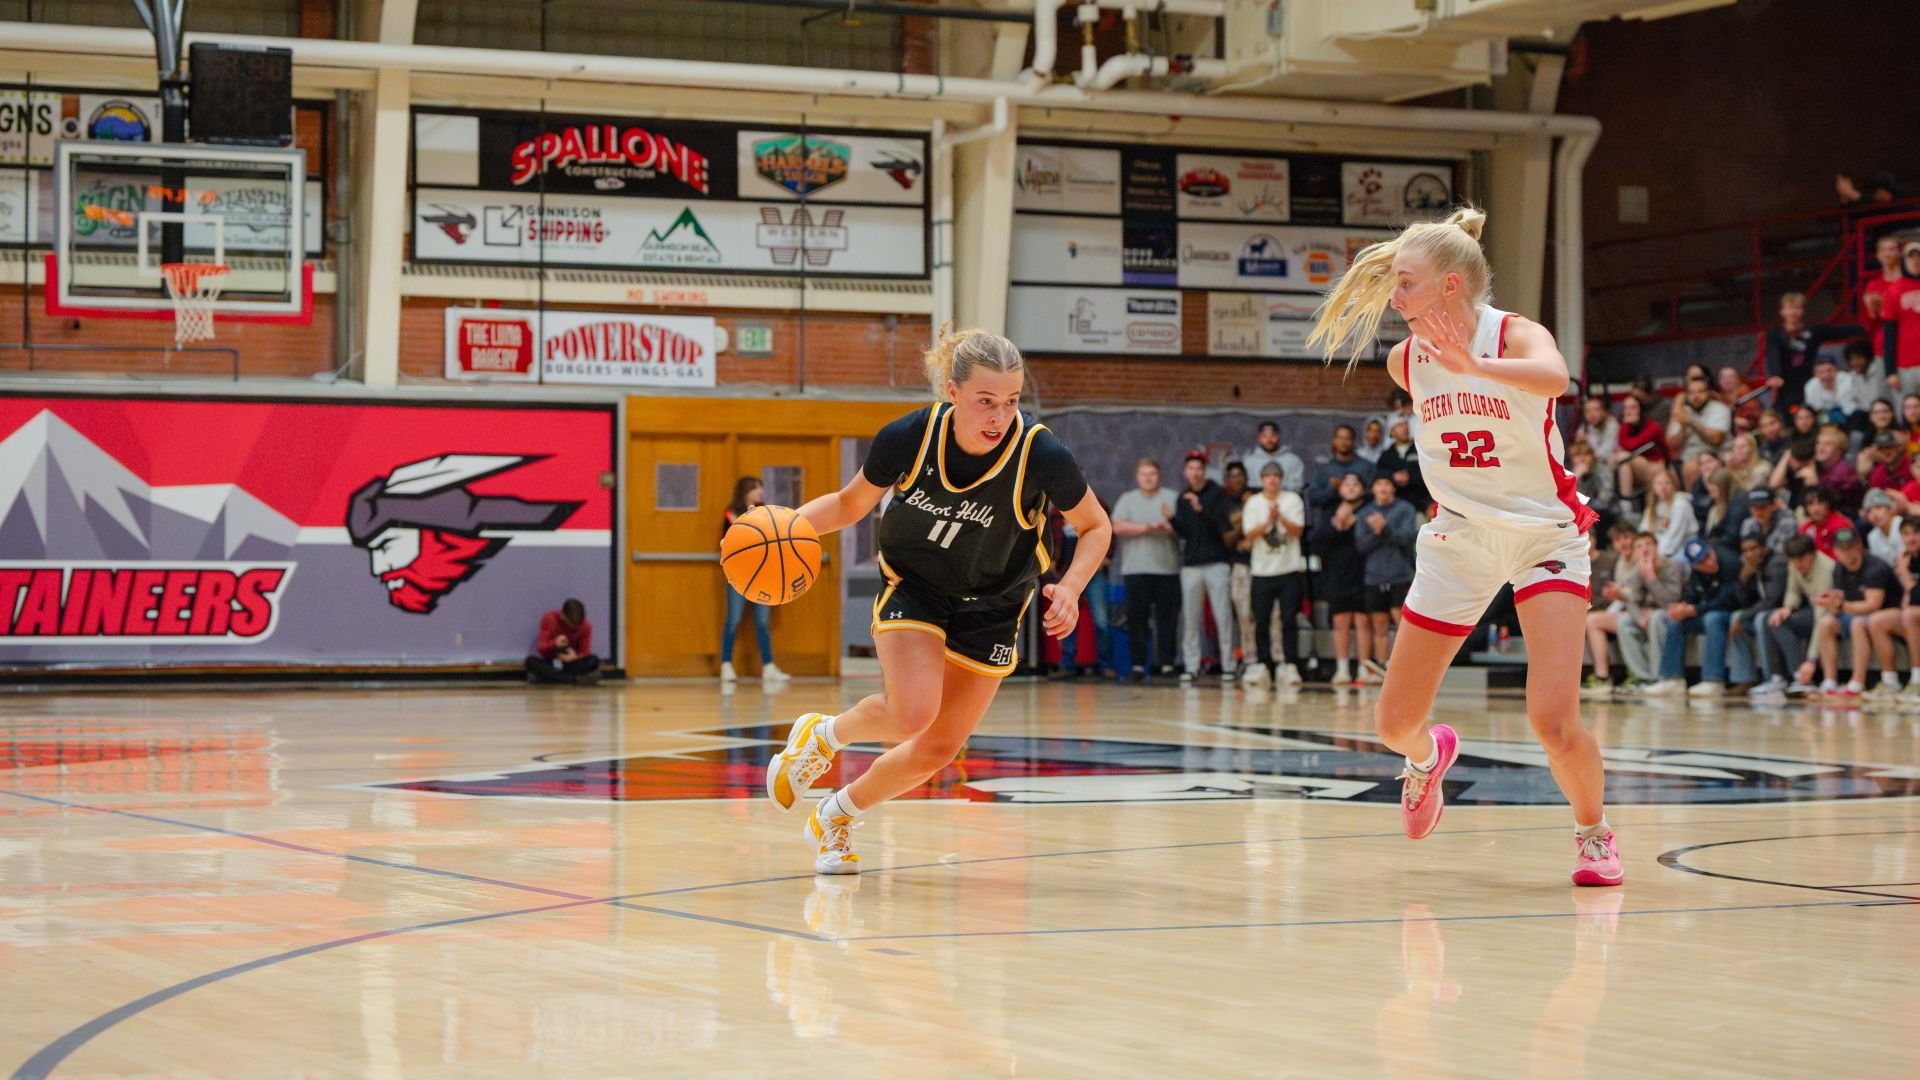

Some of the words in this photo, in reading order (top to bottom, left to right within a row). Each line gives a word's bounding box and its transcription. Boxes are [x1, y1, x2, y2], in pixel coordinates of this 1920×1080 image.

[512, 123, 709, 194] SPALLONE
[565, 166, 656, 179] CONSTRUCTION
[526, 206, 602, 218] GUNNISON
[527, 218, 605, 243] SHIPPING
[768, 229, 839, 238] WESERN
[464, 322, 489, 345] THE
[545, 321, 703, 365] POWERSTOP
[621, 366, 669, 377] WINGS
[676, 367, 704, 378] GAS
[1457, 392, 1510, 420] COLORADO
[1441, 430, 1501, 468] 22
[905, 488, 952, 516] Black
[955, 500, 994, 528] Hills
[927, 519, 963, 549] 11
[0, 568, 287, 637] TAINEERS
